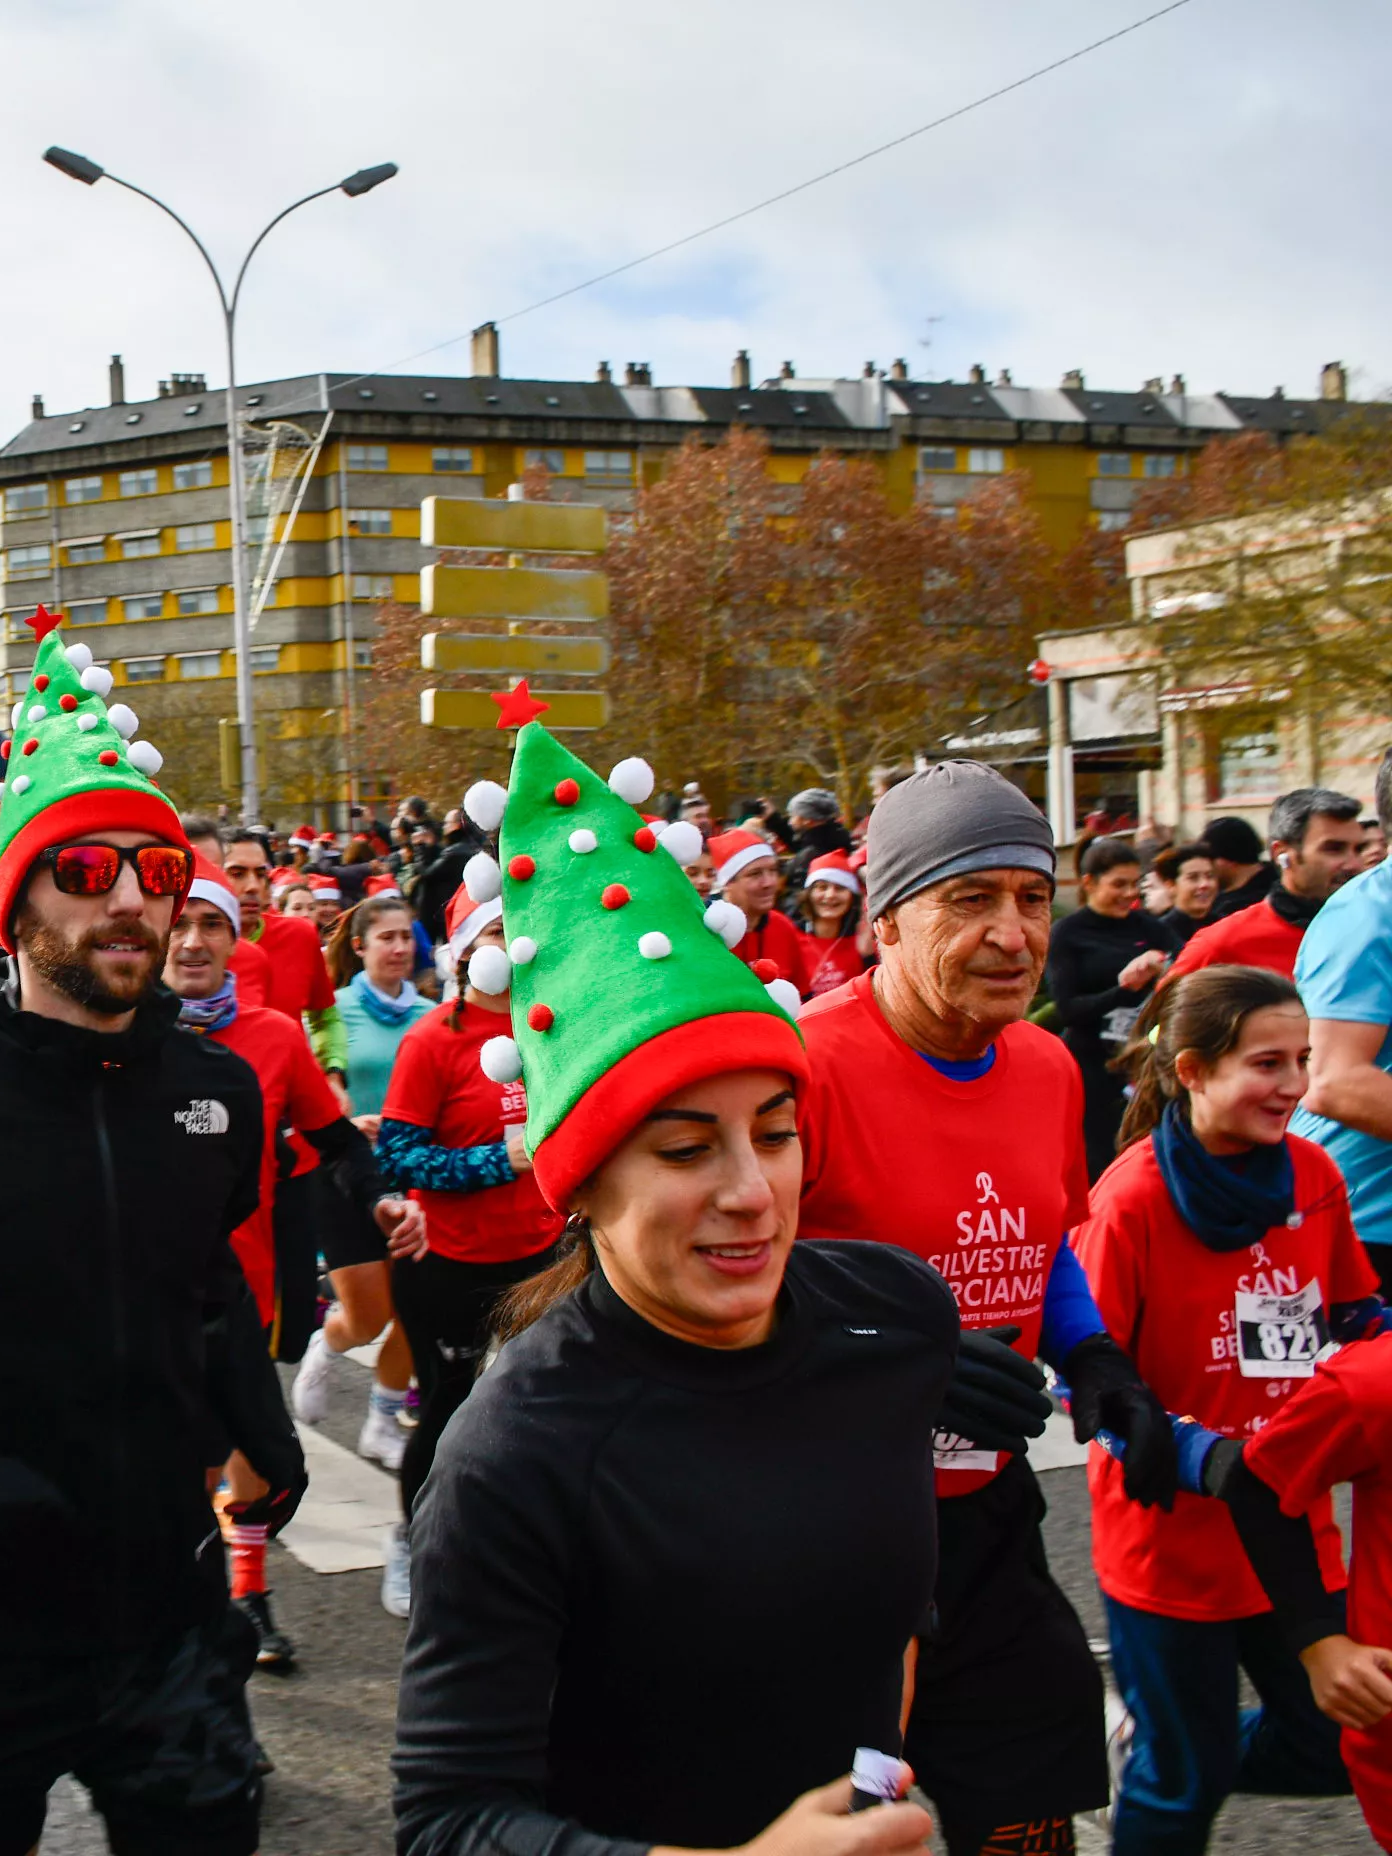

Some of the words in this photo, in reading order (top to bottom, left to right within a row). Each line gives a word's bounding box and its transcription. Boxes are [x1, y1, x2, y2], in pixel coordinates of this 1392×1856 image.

[174, 1110, 210, 1124] NORTH
[189, 1099, 210, 1113] THE
[185, 1123, 210, 1134] FACE
[956, 1207, 1026, 1246] SAN
[927, 1243, 1046, 1278] SILVESTRE
[948, 1273, 1043, 1307] RCIANA
[1237, 1265, 1298, 1297] SAN
[982, 1310, 1010, 1321] TIEMPO
